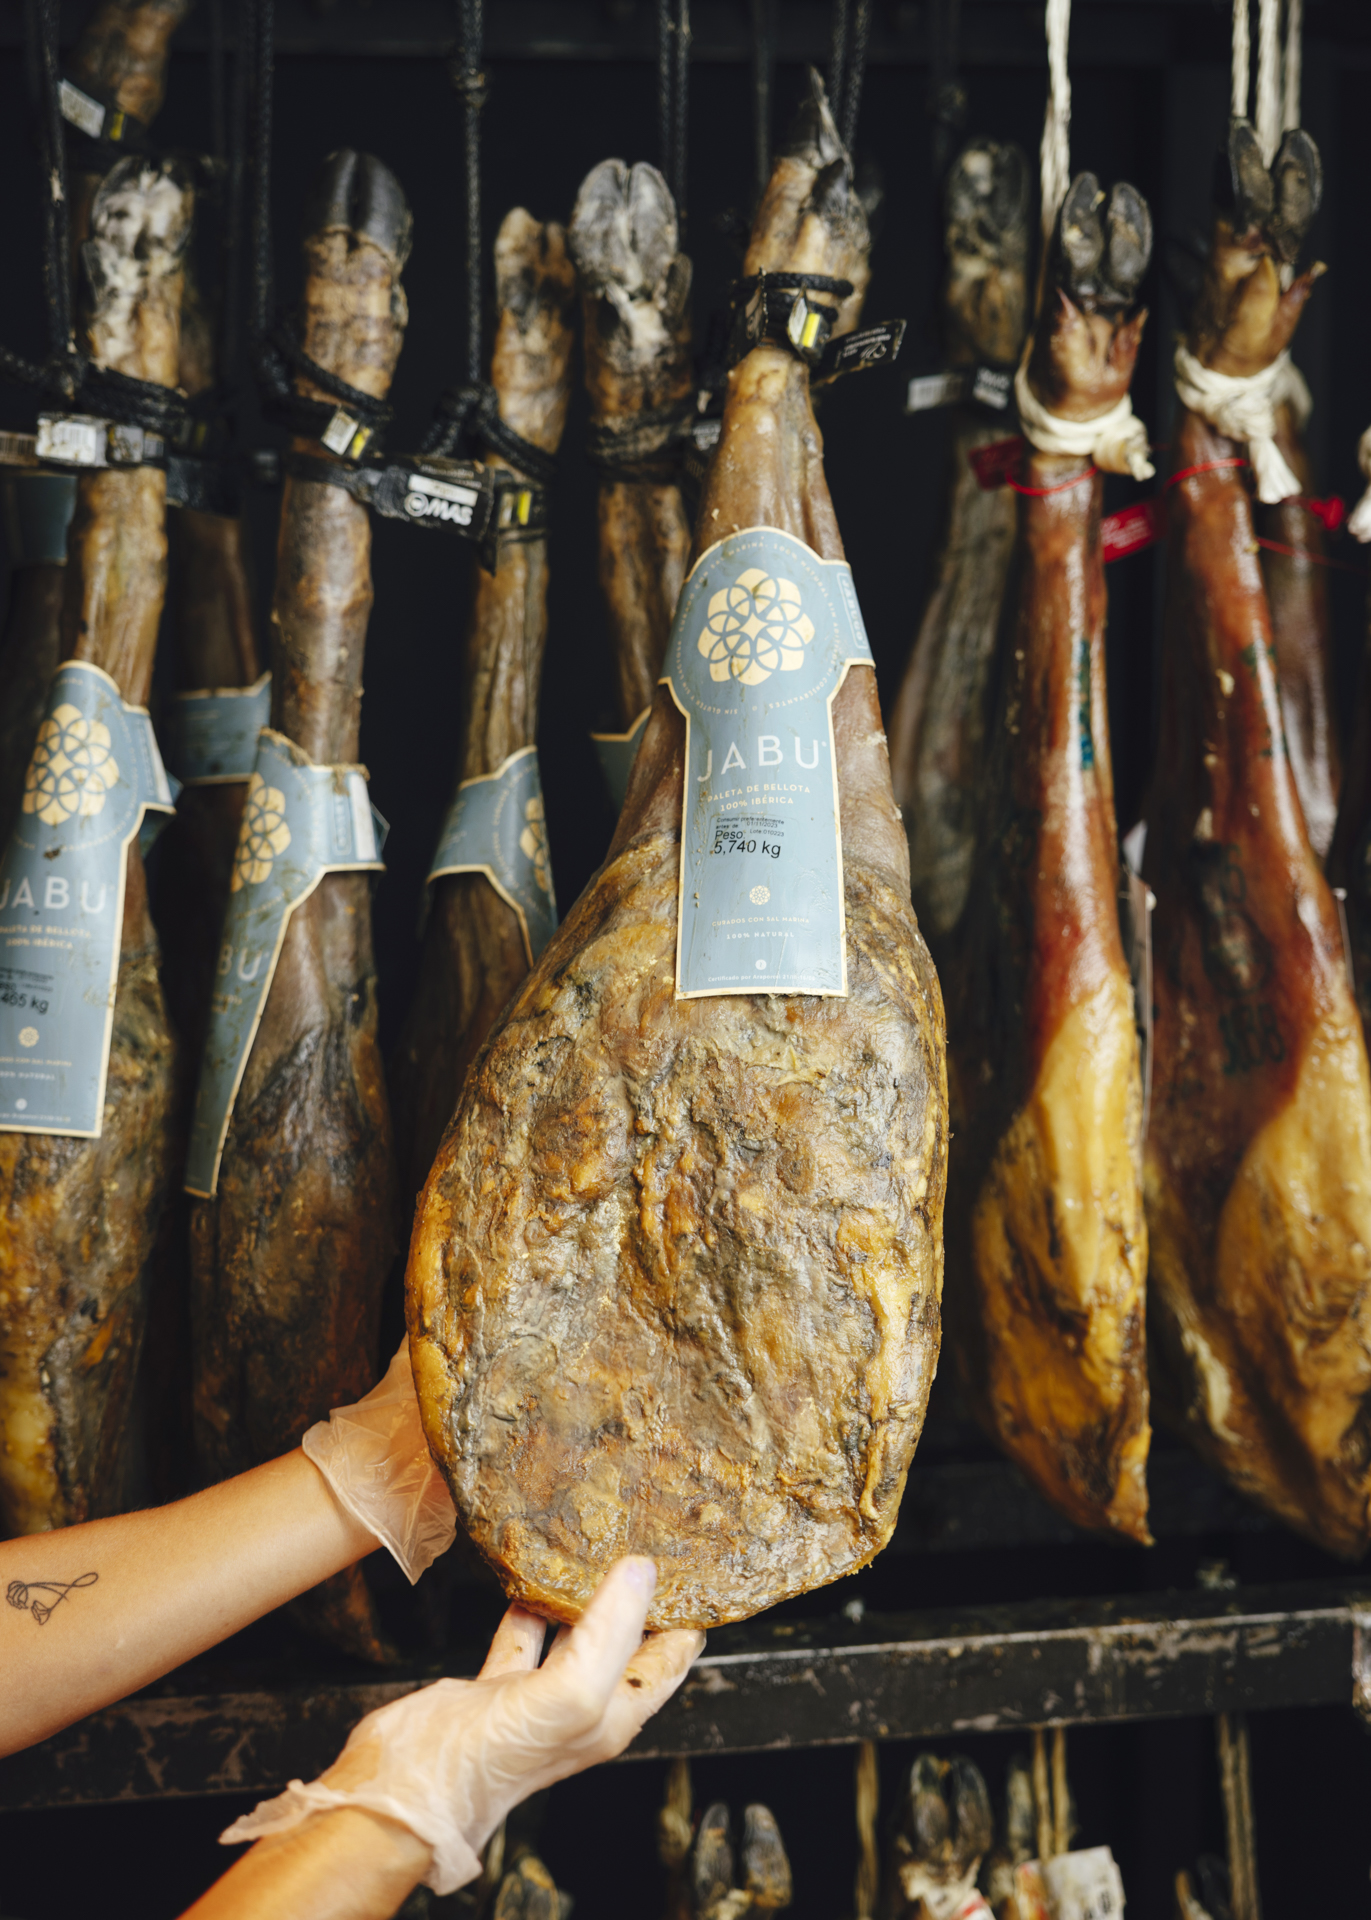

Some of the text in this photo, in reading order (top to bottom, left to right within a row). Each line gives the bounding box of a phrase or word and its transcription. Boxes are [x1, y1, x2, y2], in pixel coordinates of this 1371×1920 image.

[697, 735, 820, 782] JABU
[707, 783, 811, 803] PALETA DE BELLOTA
[720, 794, 794, 812] 100% IBÉRICA
[714, 840, 781, 859] 5,740 kg
[712, 918, 746, 927] CURADOS
[782, 916, 810, 924] MARINA
[726, 932, 750, 940] 100%
[708, 974, 739, 982] Certificado
